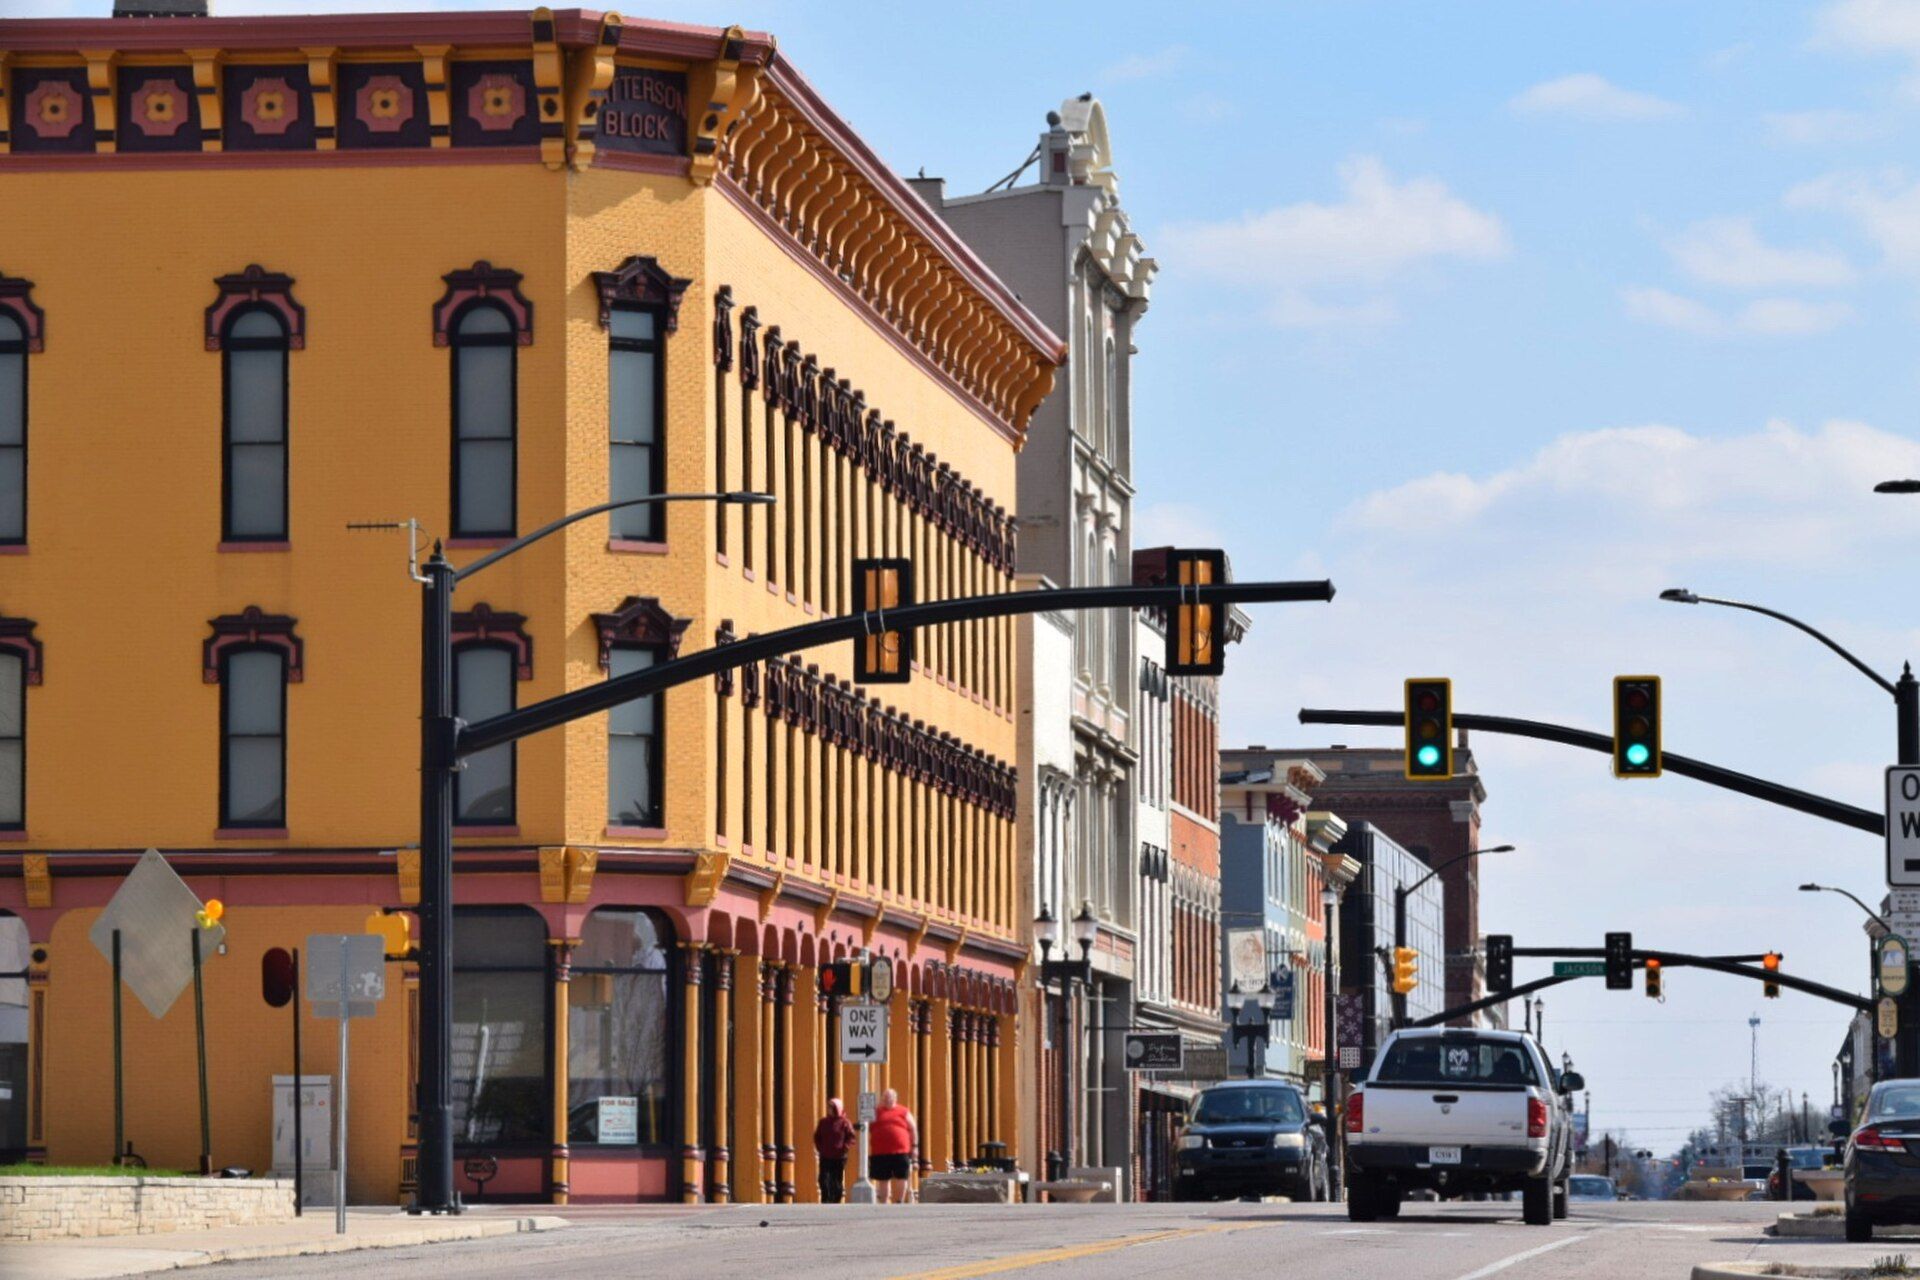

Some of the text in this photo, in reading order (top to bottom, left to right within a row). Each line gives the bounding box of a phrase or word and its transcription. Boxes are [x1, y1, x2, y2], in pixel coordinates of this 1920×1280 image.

[605, 110, 669, 140] BLOCK
[1563, 964, 1604, 974] JACKSON
[849, 1009, 877, 1023] ONE
[848, 1025, 877, 1038] WAY
